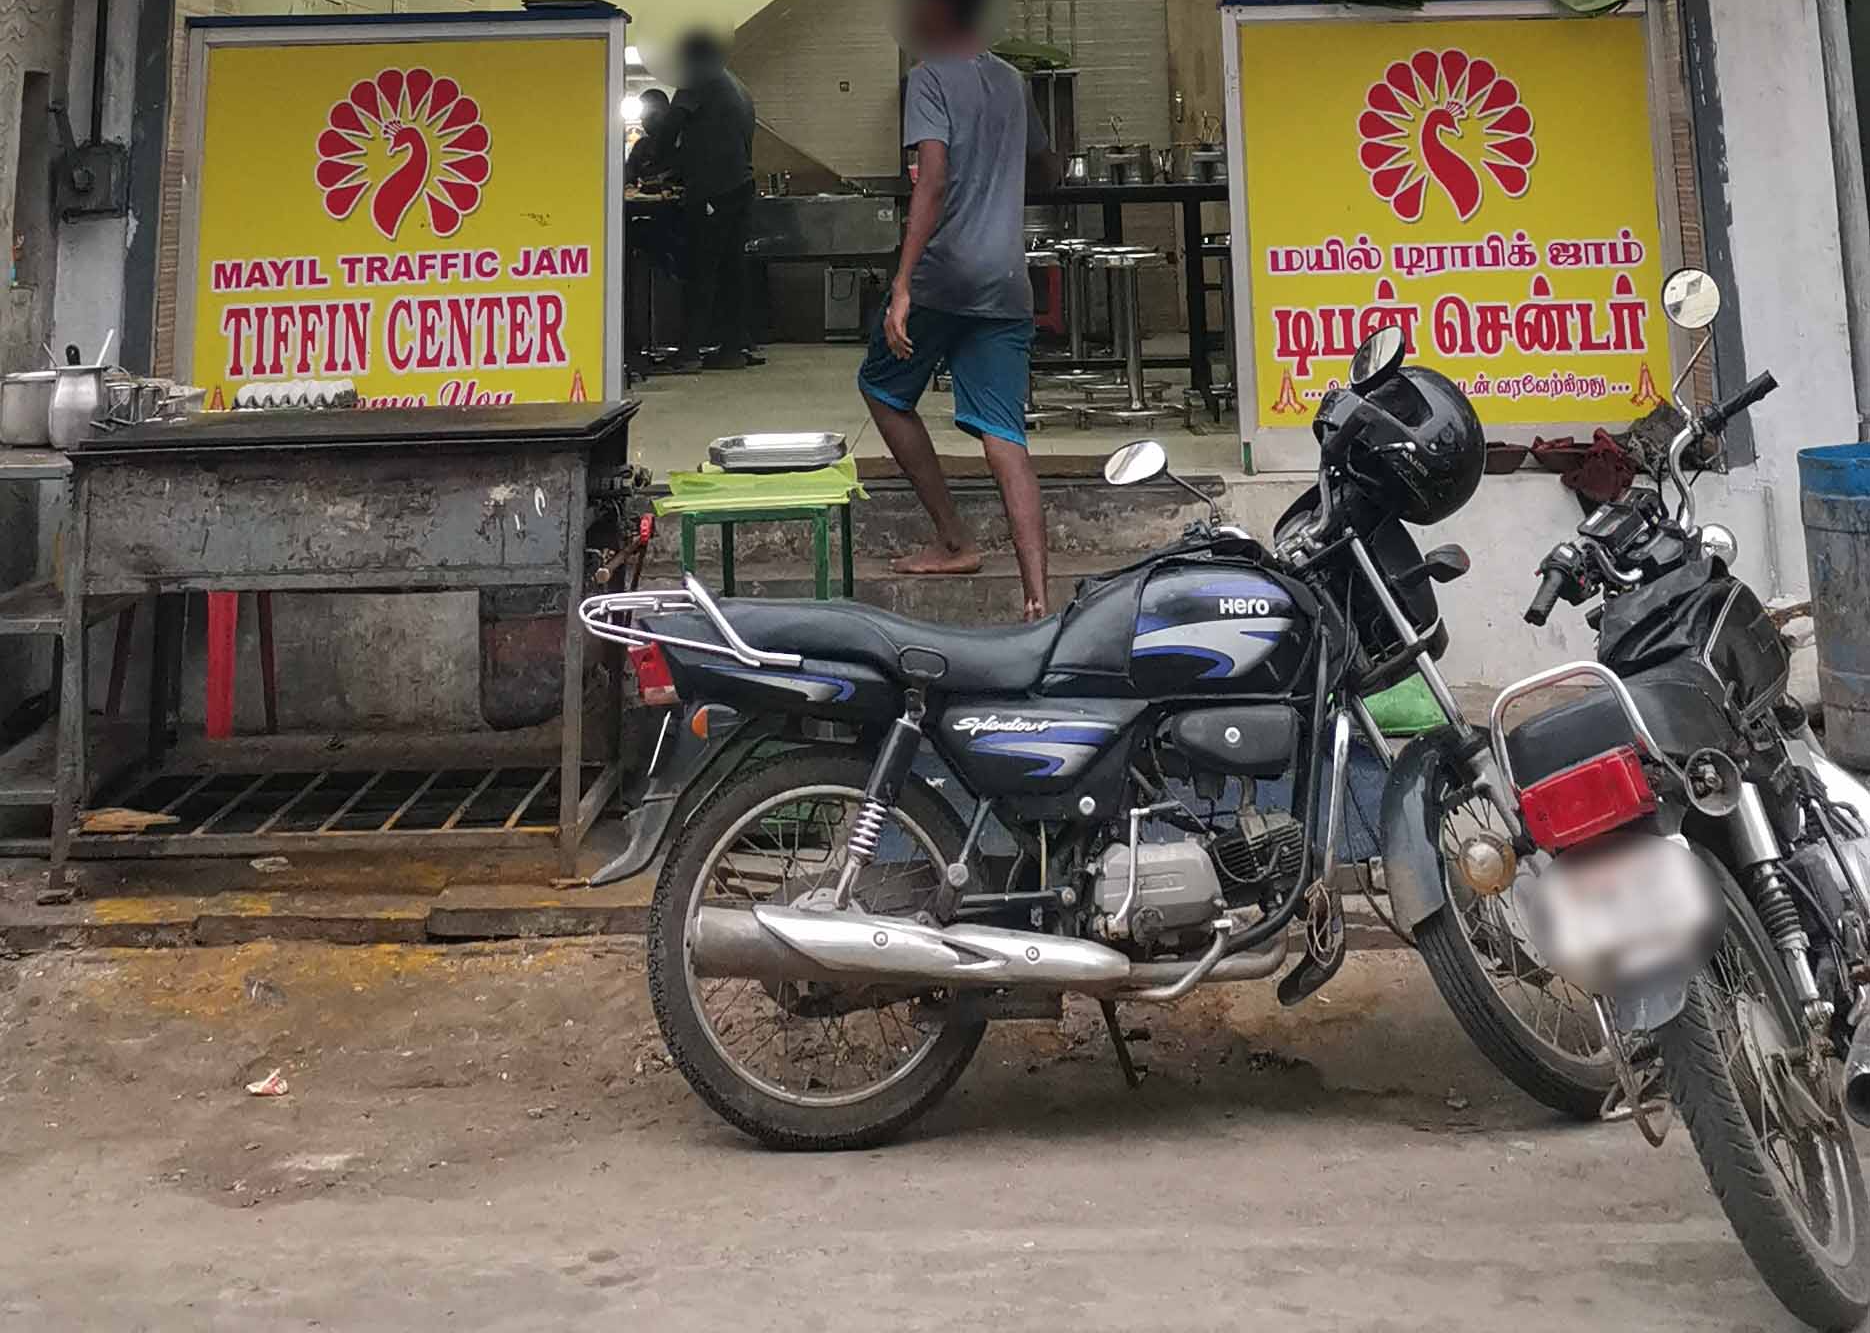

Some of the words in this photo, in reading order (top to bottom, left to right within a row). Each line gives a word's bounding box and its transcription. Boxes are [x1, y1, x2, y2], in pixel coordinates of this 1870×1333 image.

[213, 259, 328, 290] MAYIL
[341, 251, 499, 284] TRAFFIC
[511, 247, 590, 276] JAM
[1269, 236, 1381, 271] மயில்
[1395, 232, 1537, 275] டிராபிக்
[1549, 229, 1643, 267] ஜாம்
[224, 302, 371, 376] TIFFIN
[388, 294, 567, 370] CENTER
[1434, 274, 1646, 354] சென்டர்
[1219, 598, 1270, 616] Hero
